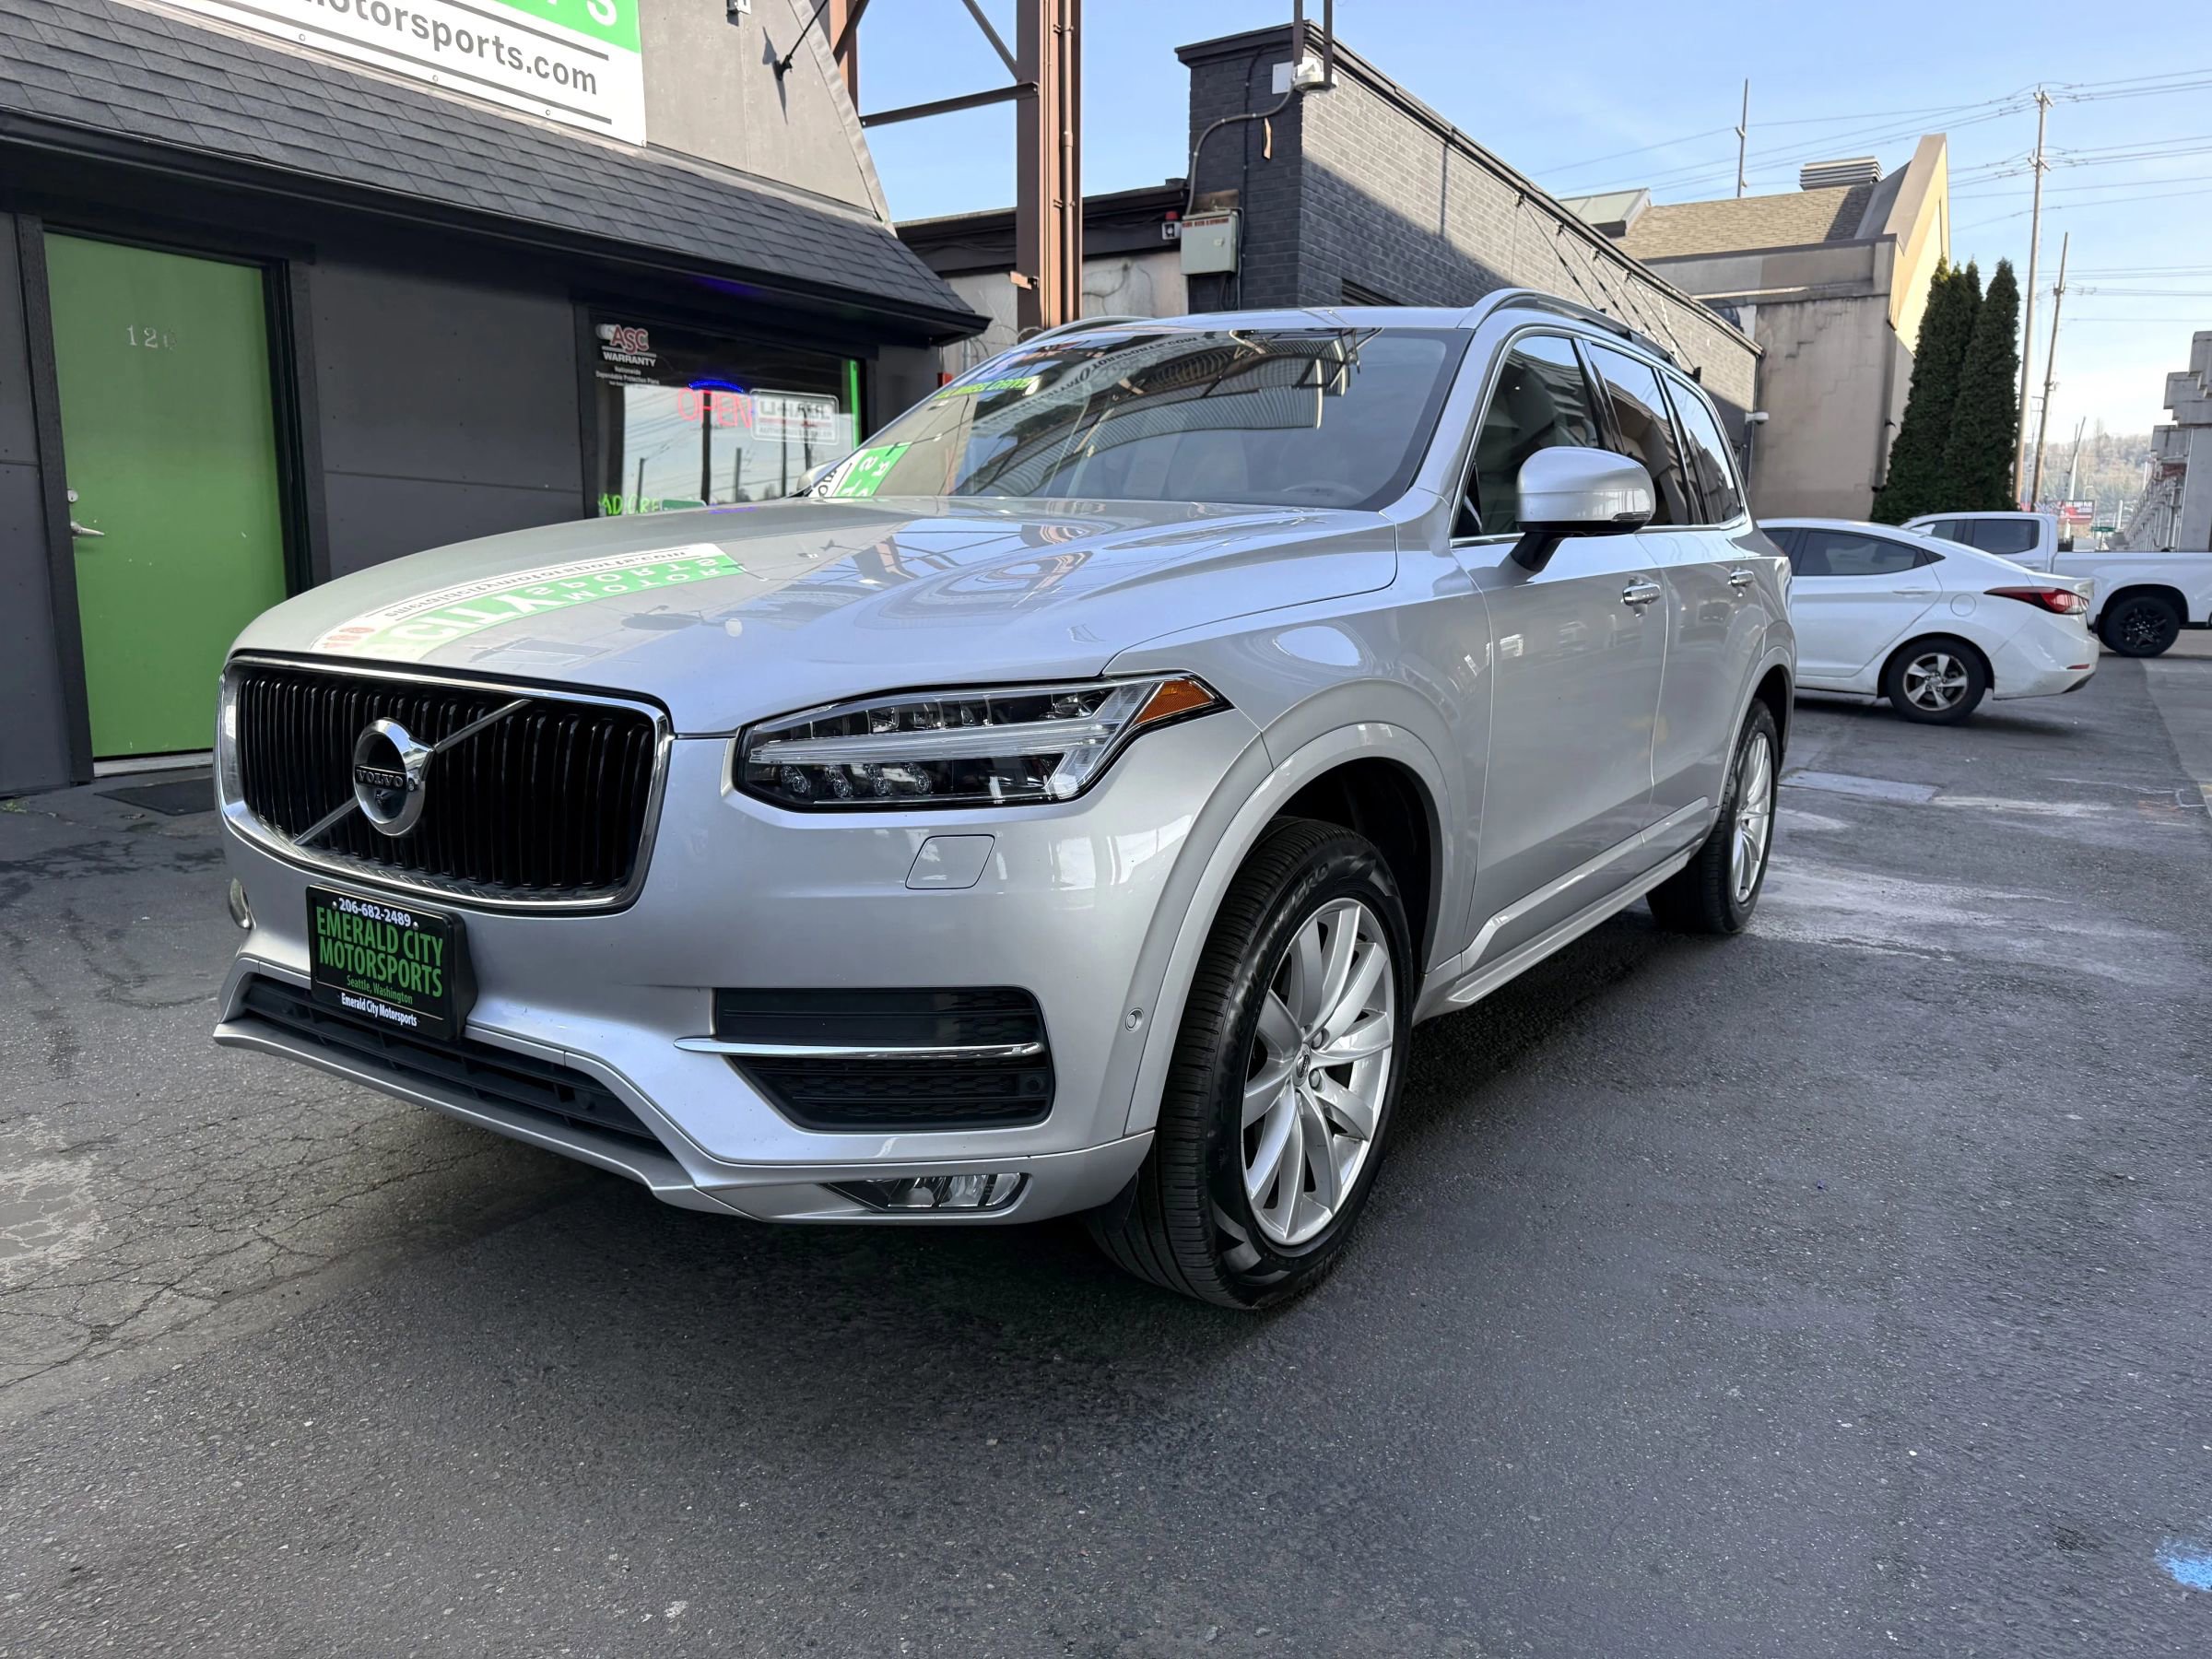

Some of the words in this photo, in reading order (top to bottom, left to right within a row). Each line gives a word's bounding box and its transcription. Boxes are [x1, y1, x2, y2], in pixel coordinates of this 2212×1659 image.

[609, 324, 650, 355] ASC
[602, 351, 657, 368] WARRANTY
[677, 387, 752, 429] OPEN
[356, 769, 405, 788] VOLVO
[338, 897, 411, 927] 206-682-2489
[316, 906, 399, 954] EMERALD
[403, 929, 443, 967] CITY
[319, 935, 443, 997] MOTORSPORTS
[347, 974, 372, 994] Seattle,
[372, 982, 413, 1005] Washington
[341, 992, 366, 1011] Emerald
[366, 1000, 379, 1018] City
[379, 1004, 418, 1027] Motorsports
